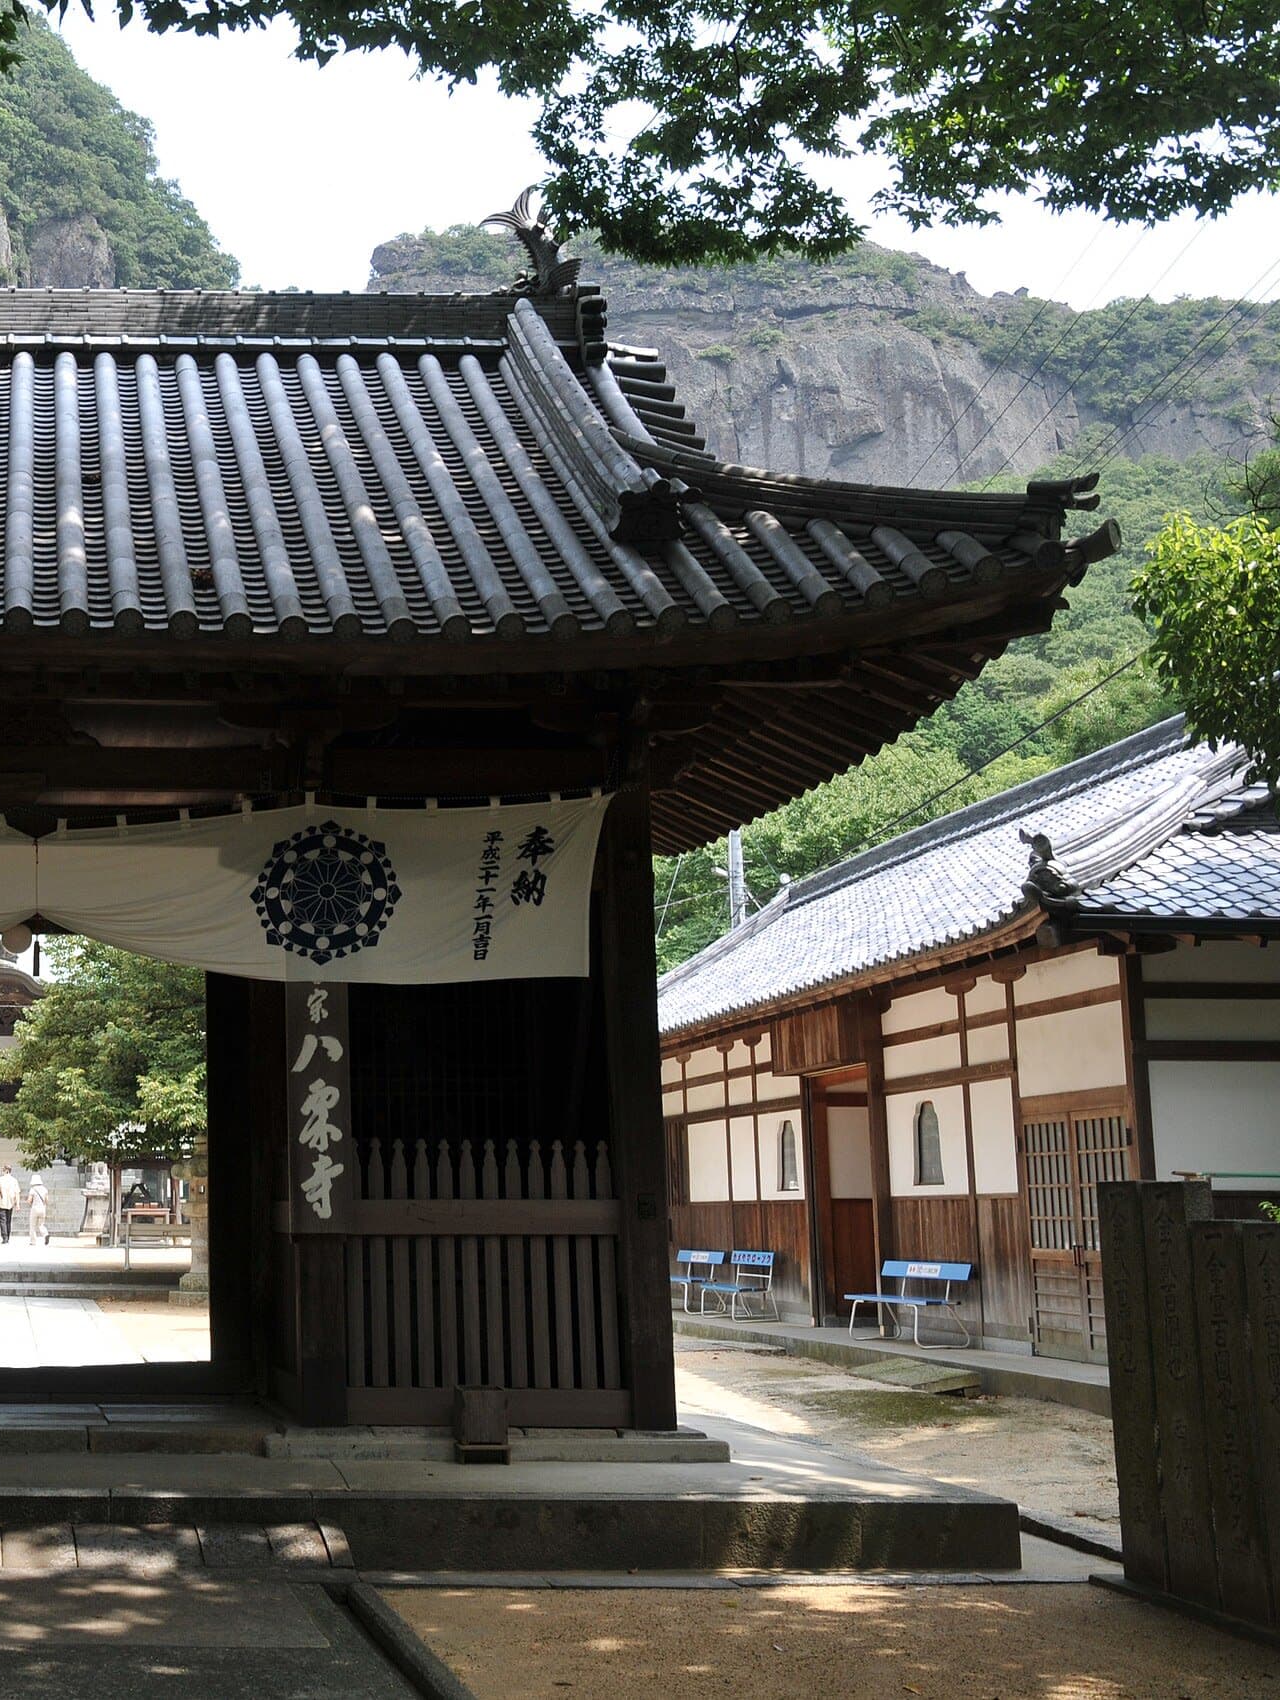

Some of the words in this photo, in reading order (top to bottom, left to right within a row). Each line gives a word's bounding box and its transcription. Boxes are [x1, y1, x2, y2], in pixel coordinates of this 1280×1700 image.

[472, 830, 505, 961] 平成二十一年一月吉日
[510, 826, 556, 907] 奉納
[290, 981, 345, 1220] 宗八栗寺
